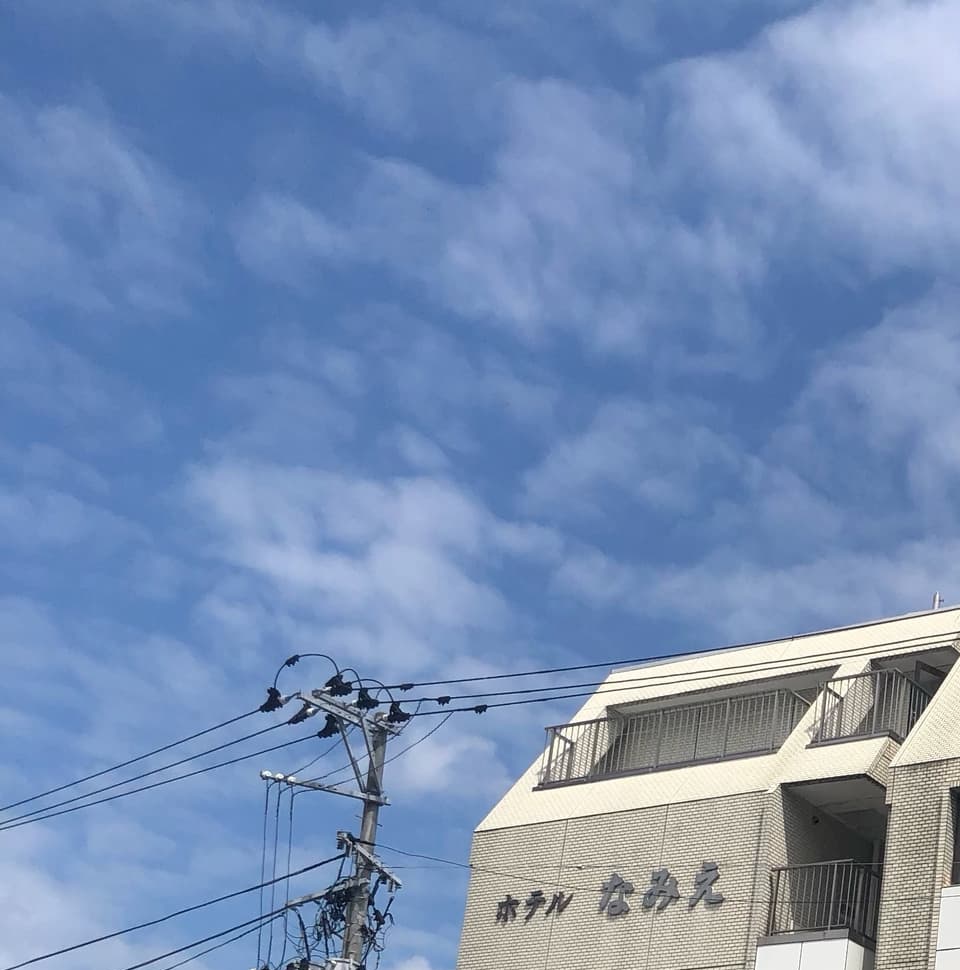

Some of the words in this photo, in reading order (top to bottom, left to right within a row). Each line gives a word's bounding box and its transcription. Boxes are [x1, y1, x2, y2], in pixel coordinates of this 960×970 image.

[496, 889, 573, 922] ホテル
[600, 861, 724, 916] なみえ
